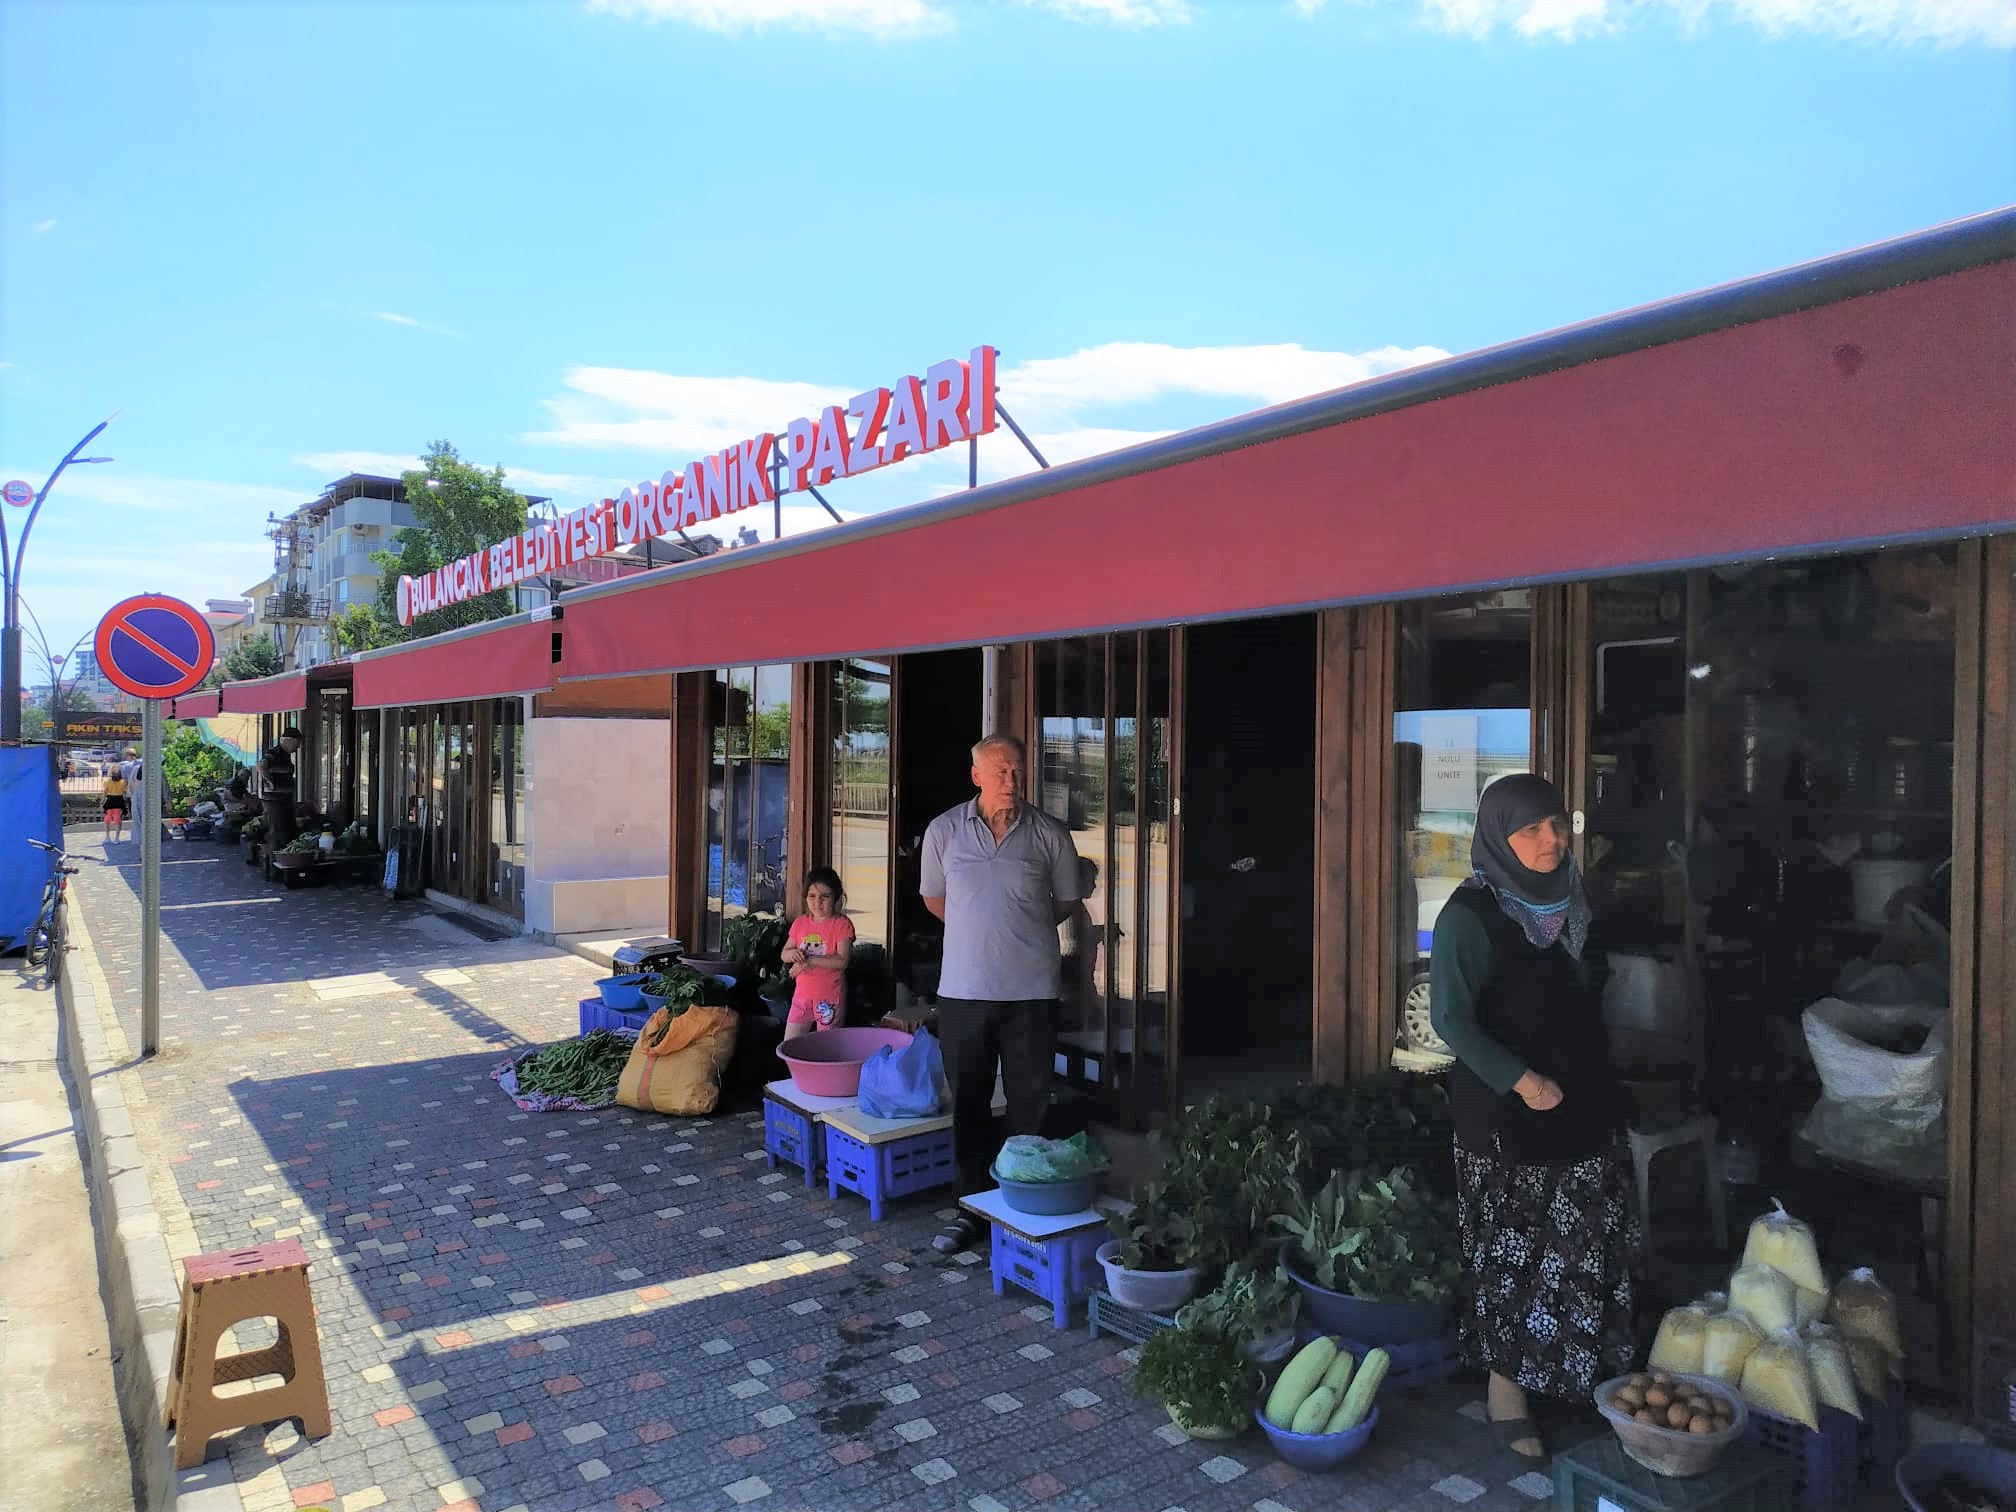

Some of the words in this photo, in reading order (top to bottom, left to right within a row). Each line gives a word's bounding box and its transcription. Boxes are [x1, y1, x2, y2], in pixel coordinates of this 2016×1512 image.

[411, 549, 491, 617] BULANCAK
[787, 344, 996, 493] PAZARI
[66, 724, 100, 733] AKIN
[103, 724, 142, 734] TAKS
